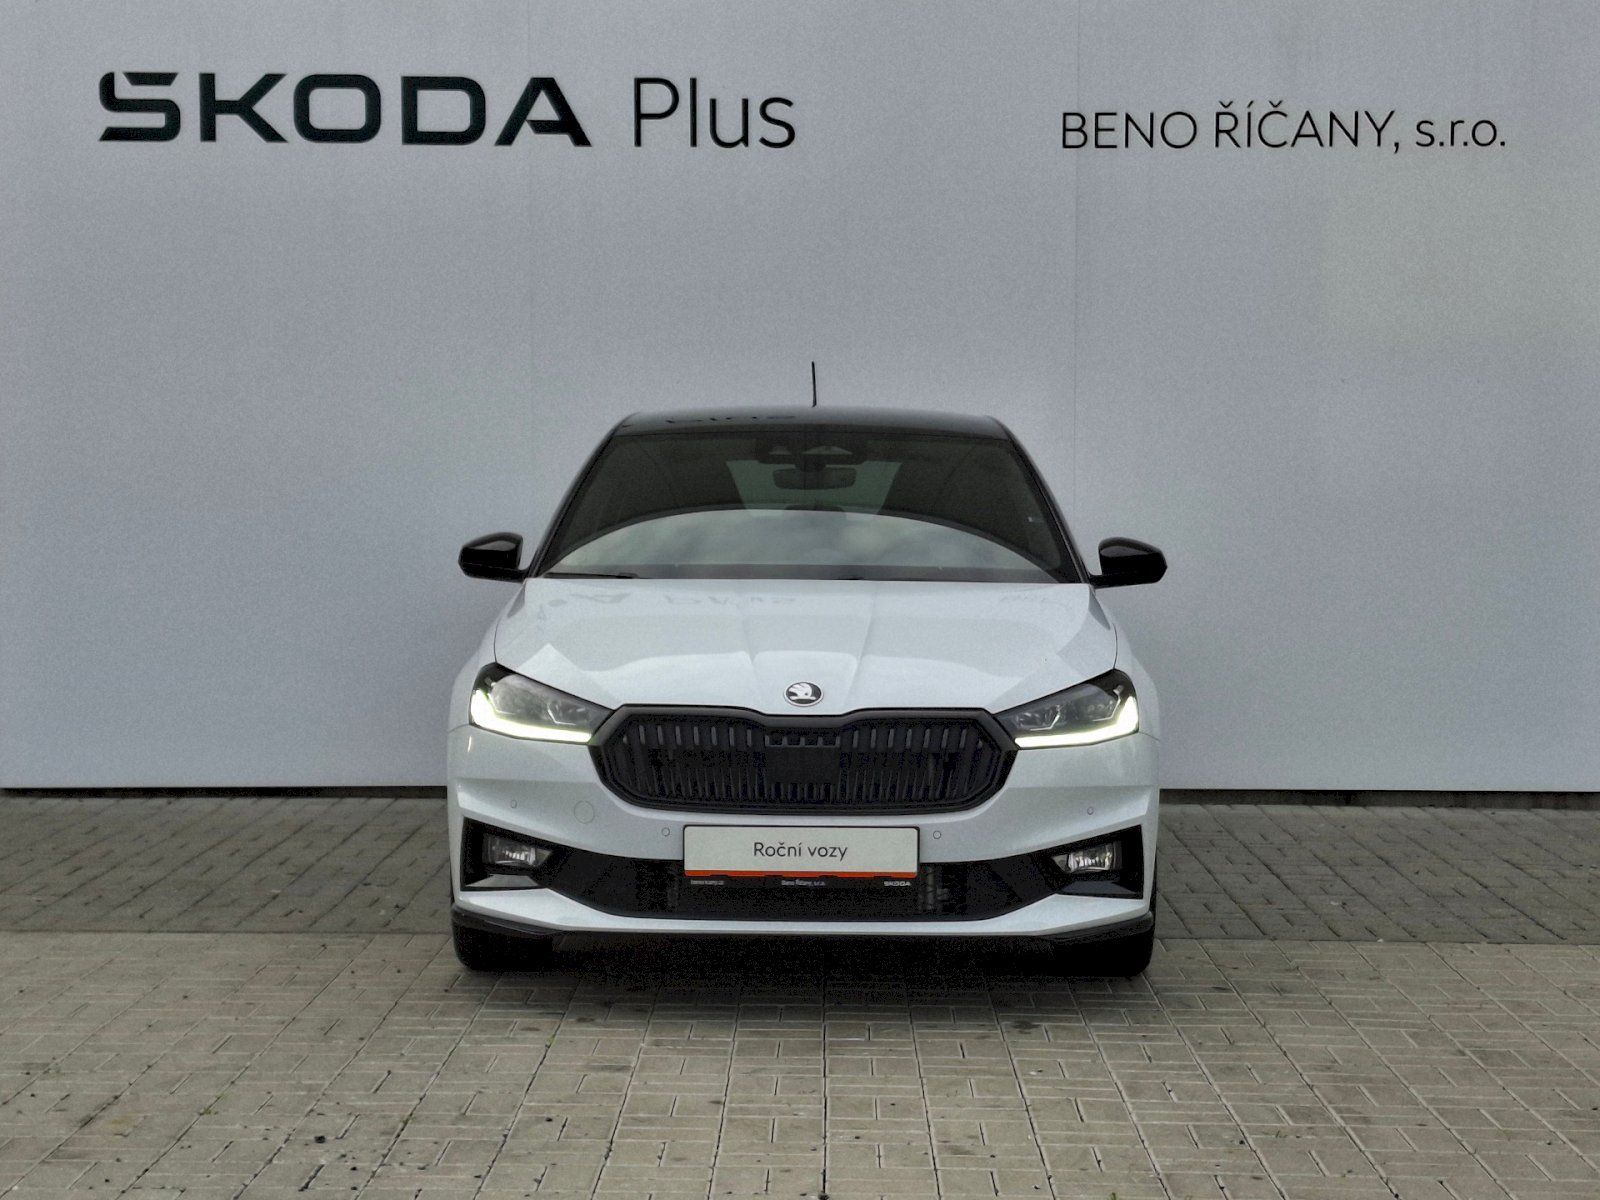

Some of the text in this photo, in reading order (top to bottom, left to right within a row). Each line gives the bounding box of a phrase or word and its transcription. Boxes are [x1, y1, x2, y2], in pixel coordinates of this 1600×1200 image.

[634, 76, 796, 149] Plus
[1061, 99, 1506, 155] BENO ŘÍČANY, s.r.o.
[753, 841, 849, 862] Roční vozy
